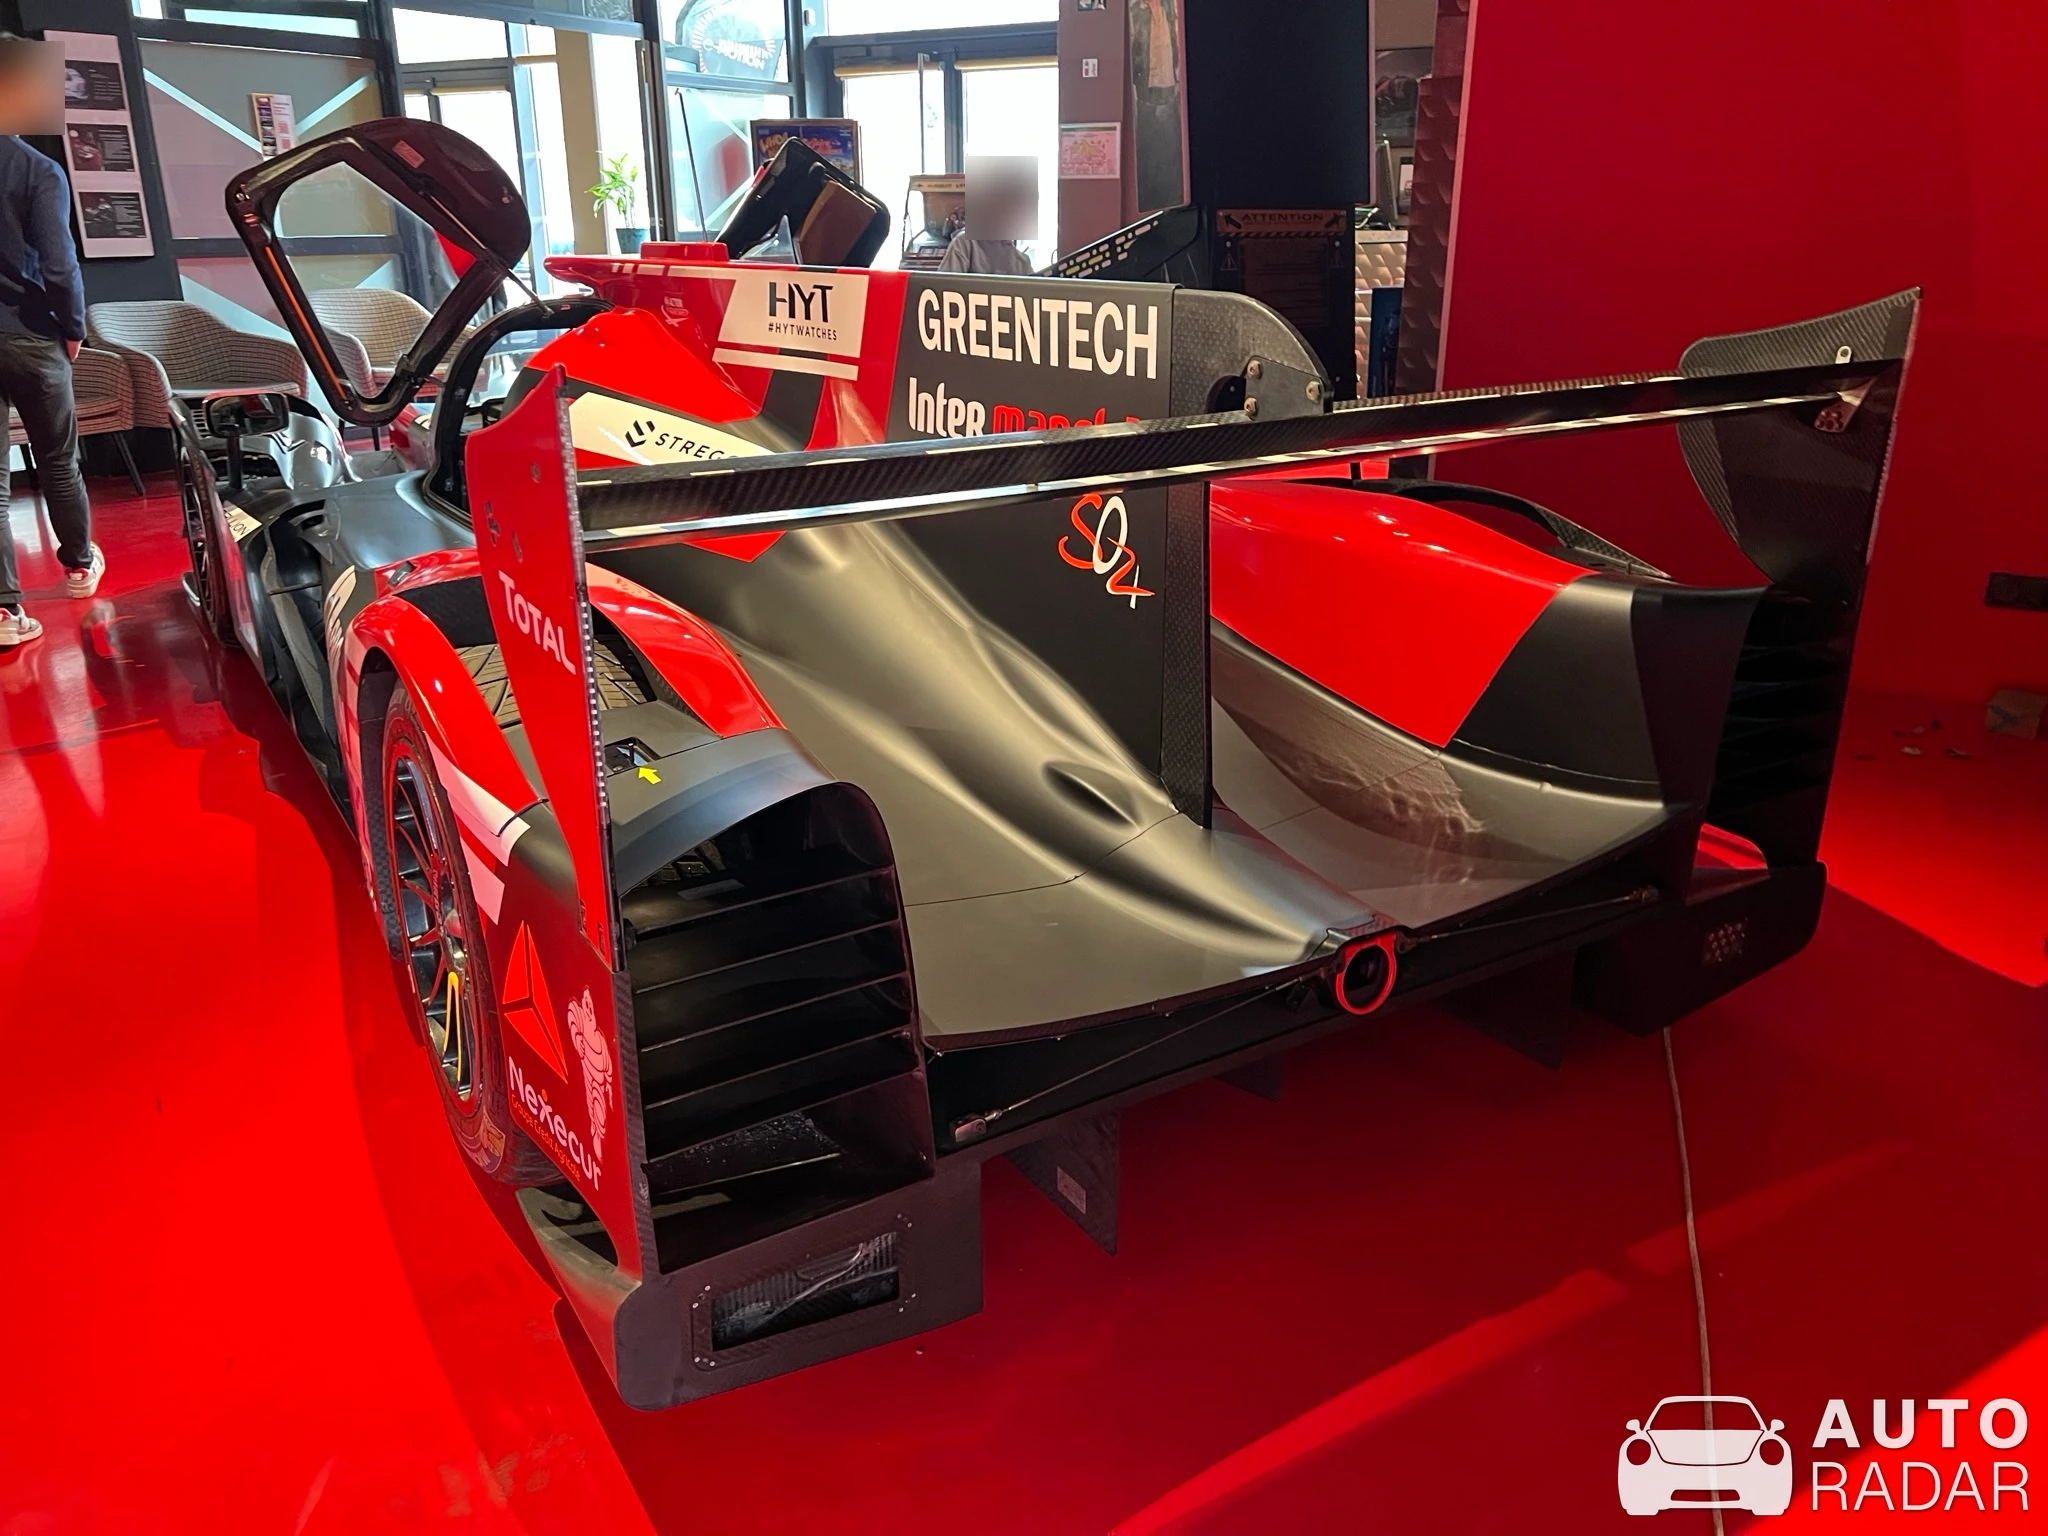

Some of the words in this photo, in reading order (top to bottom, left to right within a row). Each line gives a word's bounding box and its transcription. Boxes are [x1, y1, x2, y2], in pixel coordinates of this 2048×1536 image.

[1241, 213, 1324, 221] ATTENTION
[769, 282, 834, 323] HYT
[768, 322, 837, 341] #HYTWATCHES
[917, 288, 1158, 380] GREENTECH
[654, 432, 738, 460] STREG
[498, 569, 577, 675] TOTAL
[508, 1055, 602, 1192] Nexecur
[554, 1142, 581, 1182] Agricole
